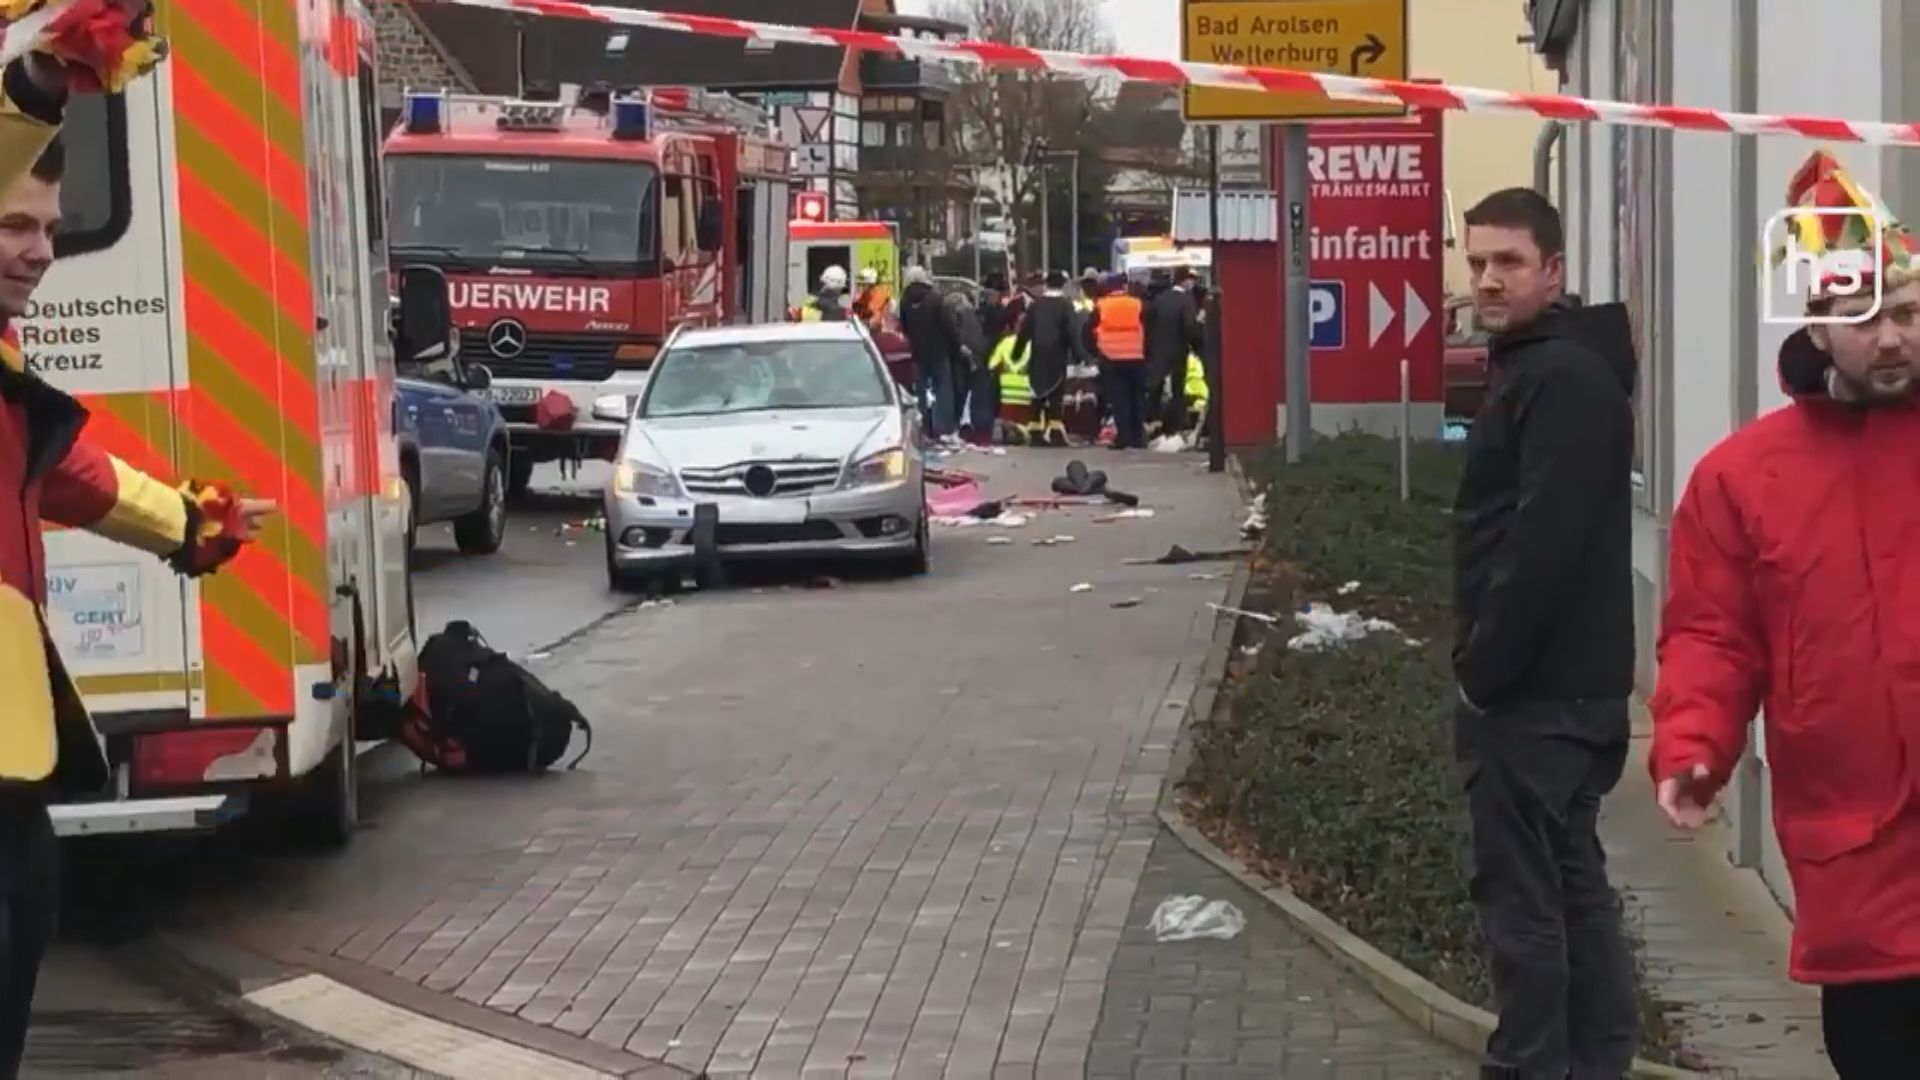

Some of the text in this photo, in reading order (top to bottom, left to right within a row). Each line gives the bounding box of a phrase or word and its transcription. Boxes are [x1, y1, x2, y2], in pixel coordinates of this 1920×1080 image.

[1196, 15, 1339, 35] Bad Arolsen
[1308, 145, 1424, 181] REWE
[1311, 182, 1431, 198] TRÄNKEMARKT
[1310, 226, 1431, 260] infahrt
[24, 296, 166, 319] Deutsches
[449, 282, 611, 312] UERWEHR
[23, 325, 101, 346] Rotes
[24, 352, 103, 372] Kreuz
[48, 575, 78, 593] ÜV
